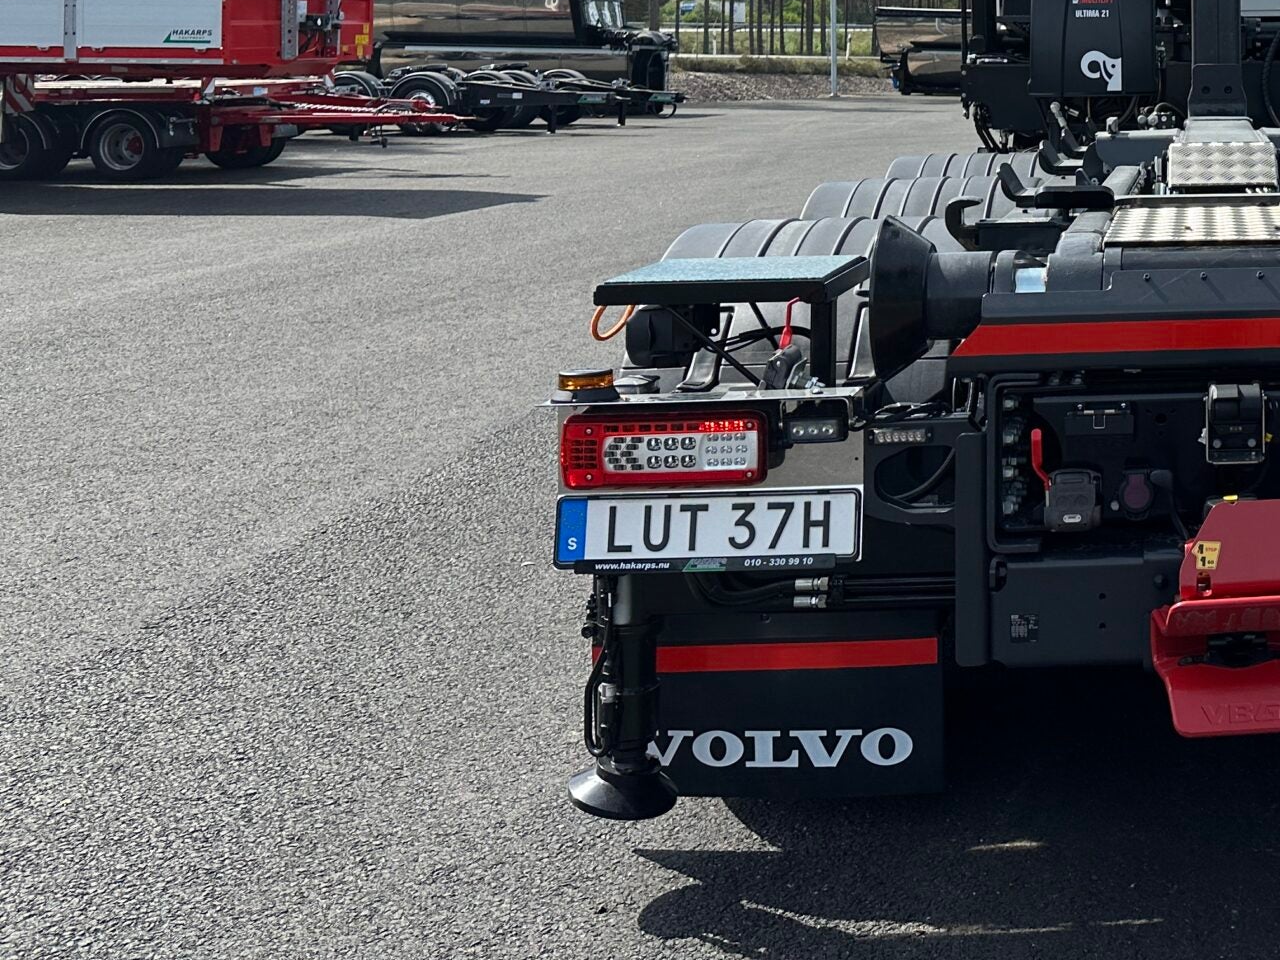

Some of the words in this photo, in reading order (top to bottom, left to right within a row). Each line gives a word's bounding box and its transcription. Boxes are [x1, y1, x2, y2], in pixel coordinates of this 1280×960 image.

[1075, 9, 1100, 18] ULTIMA
[1101, 9, 1109, 18] 21
[606, 504, 709, 553] LUT
[728, 500, 831, 550] 37H
[567, 537, 577, 550] S
[595, 561, 670, 571] www.hakarps.nu
[744, 558, 762, 567] 010
[769, 558, 786, 566] 330
[788, 557, 800, 566] 99
[802, 556, 814, 565] 10
